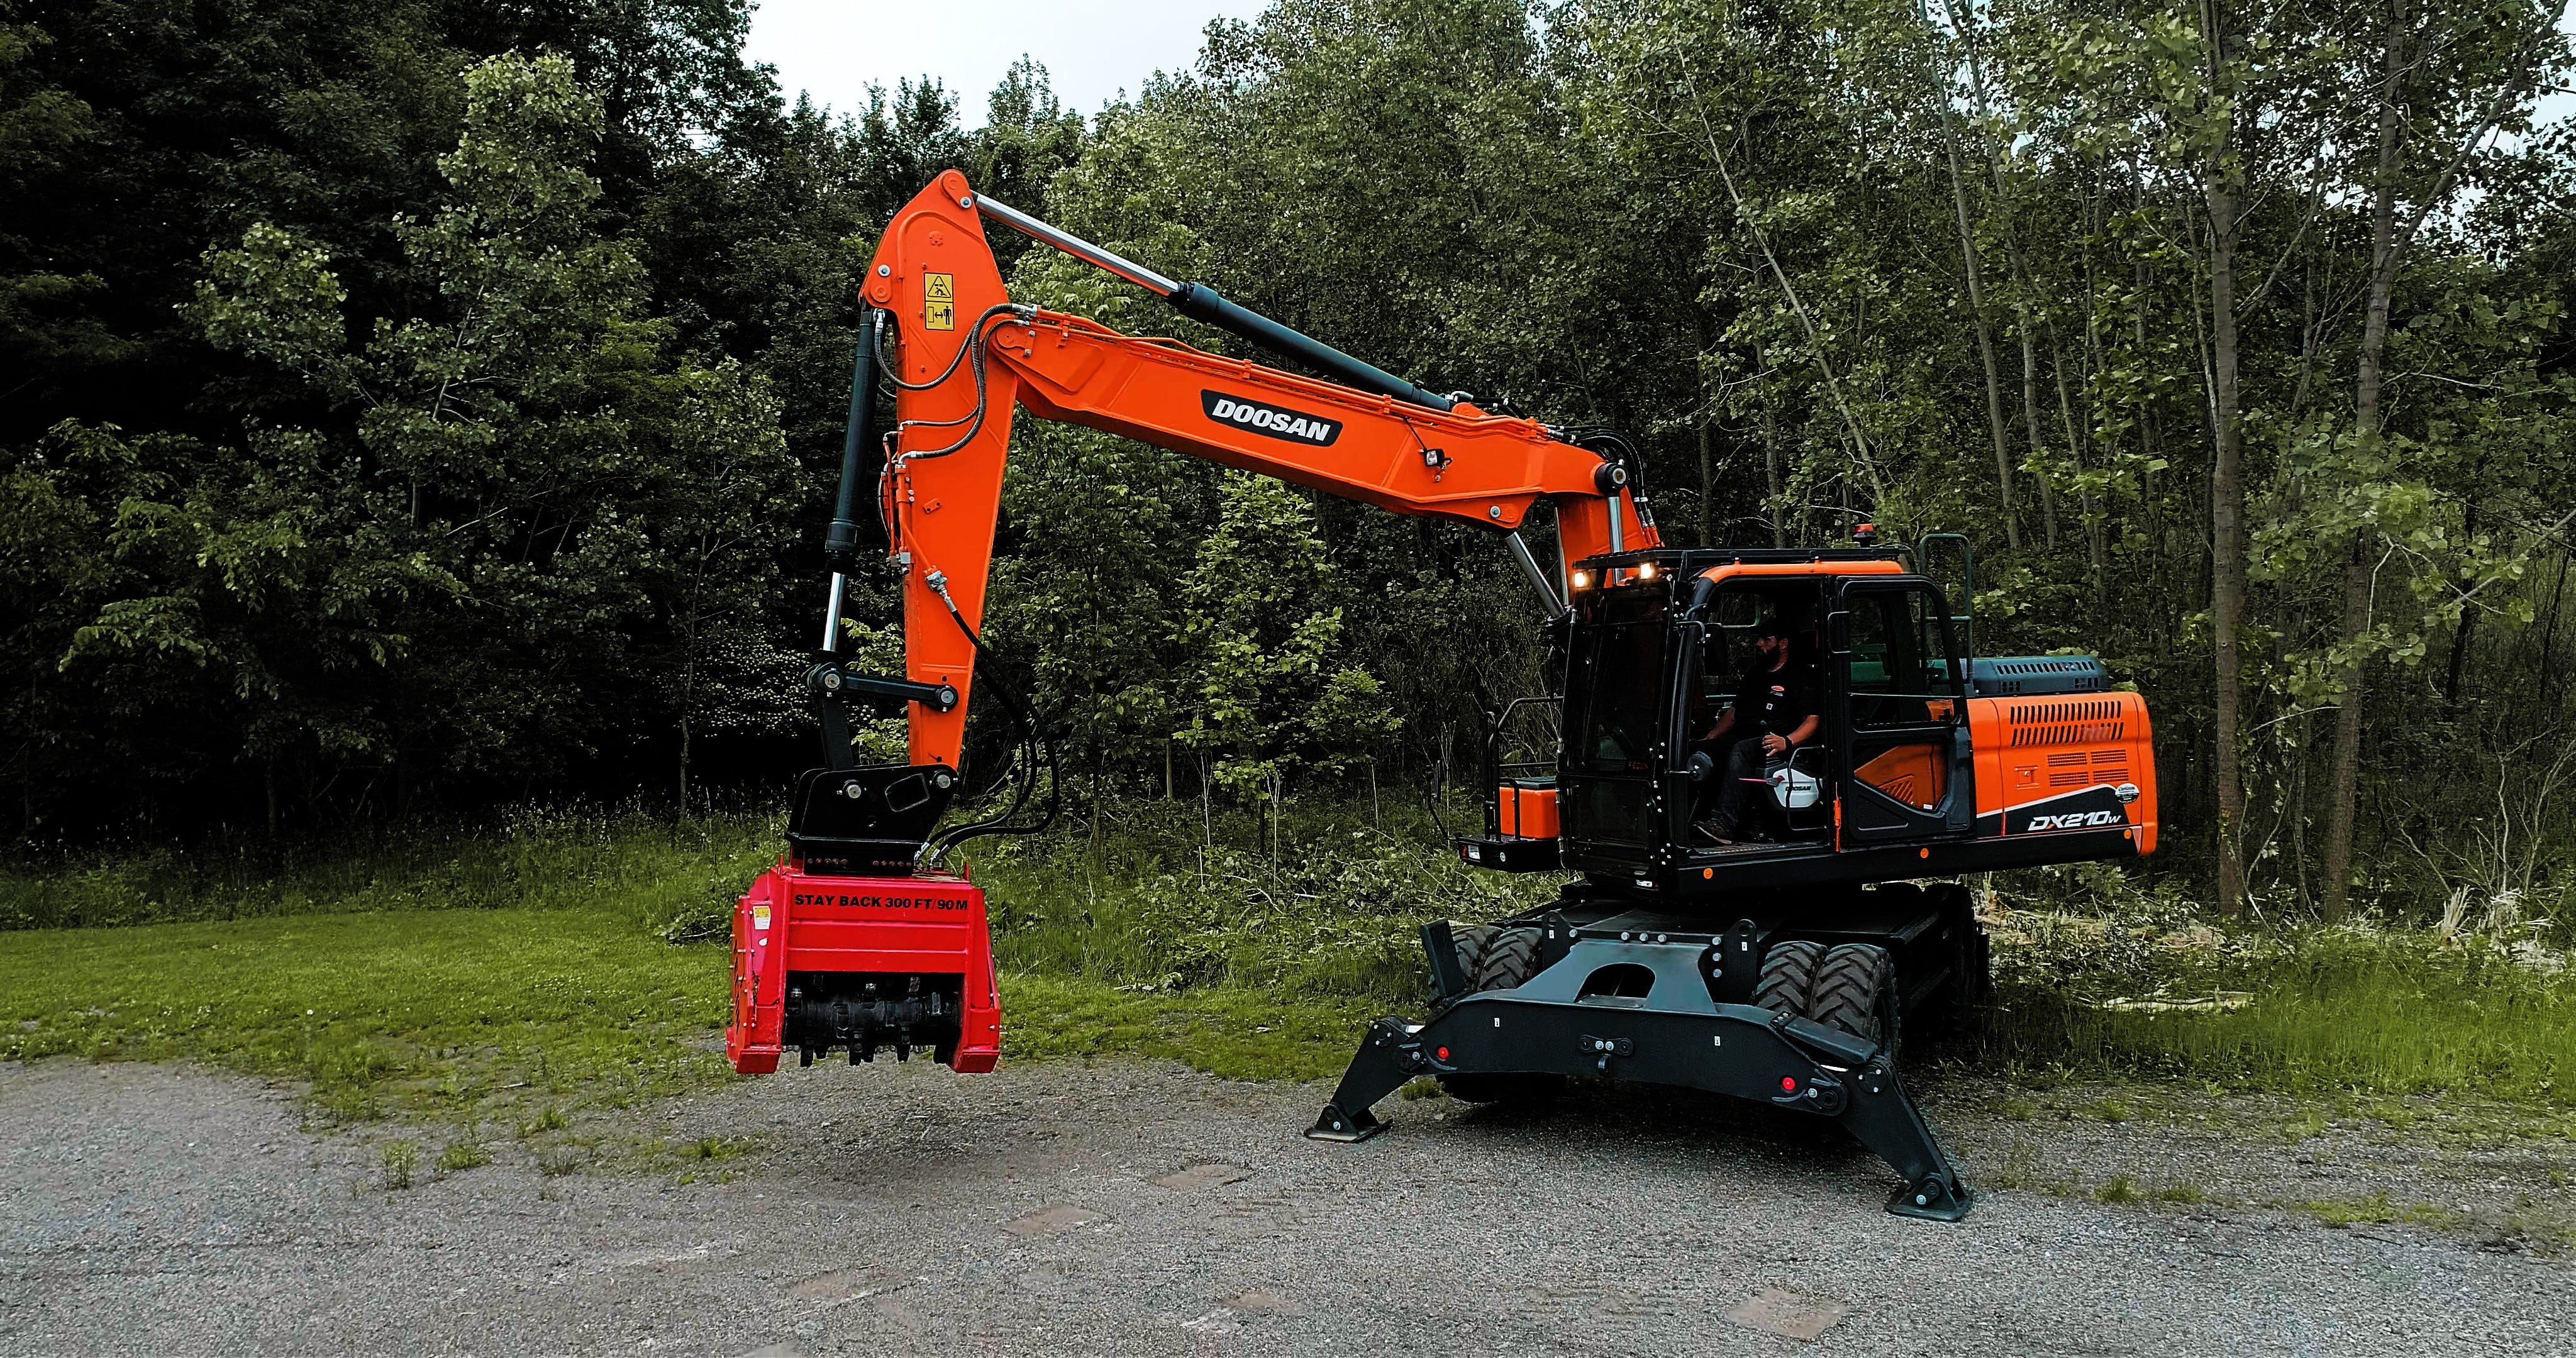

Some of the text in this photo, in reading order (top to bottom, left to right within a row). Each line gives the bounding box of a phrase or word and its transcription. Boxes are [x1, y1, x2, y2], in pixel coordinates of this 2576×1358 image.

[1212, 399, 1331, 441] DOOSAN
[794, 894, 835, 905] STAY
[839, 895, 882, 907] BACK
[885, 897, 911, 908] 300
